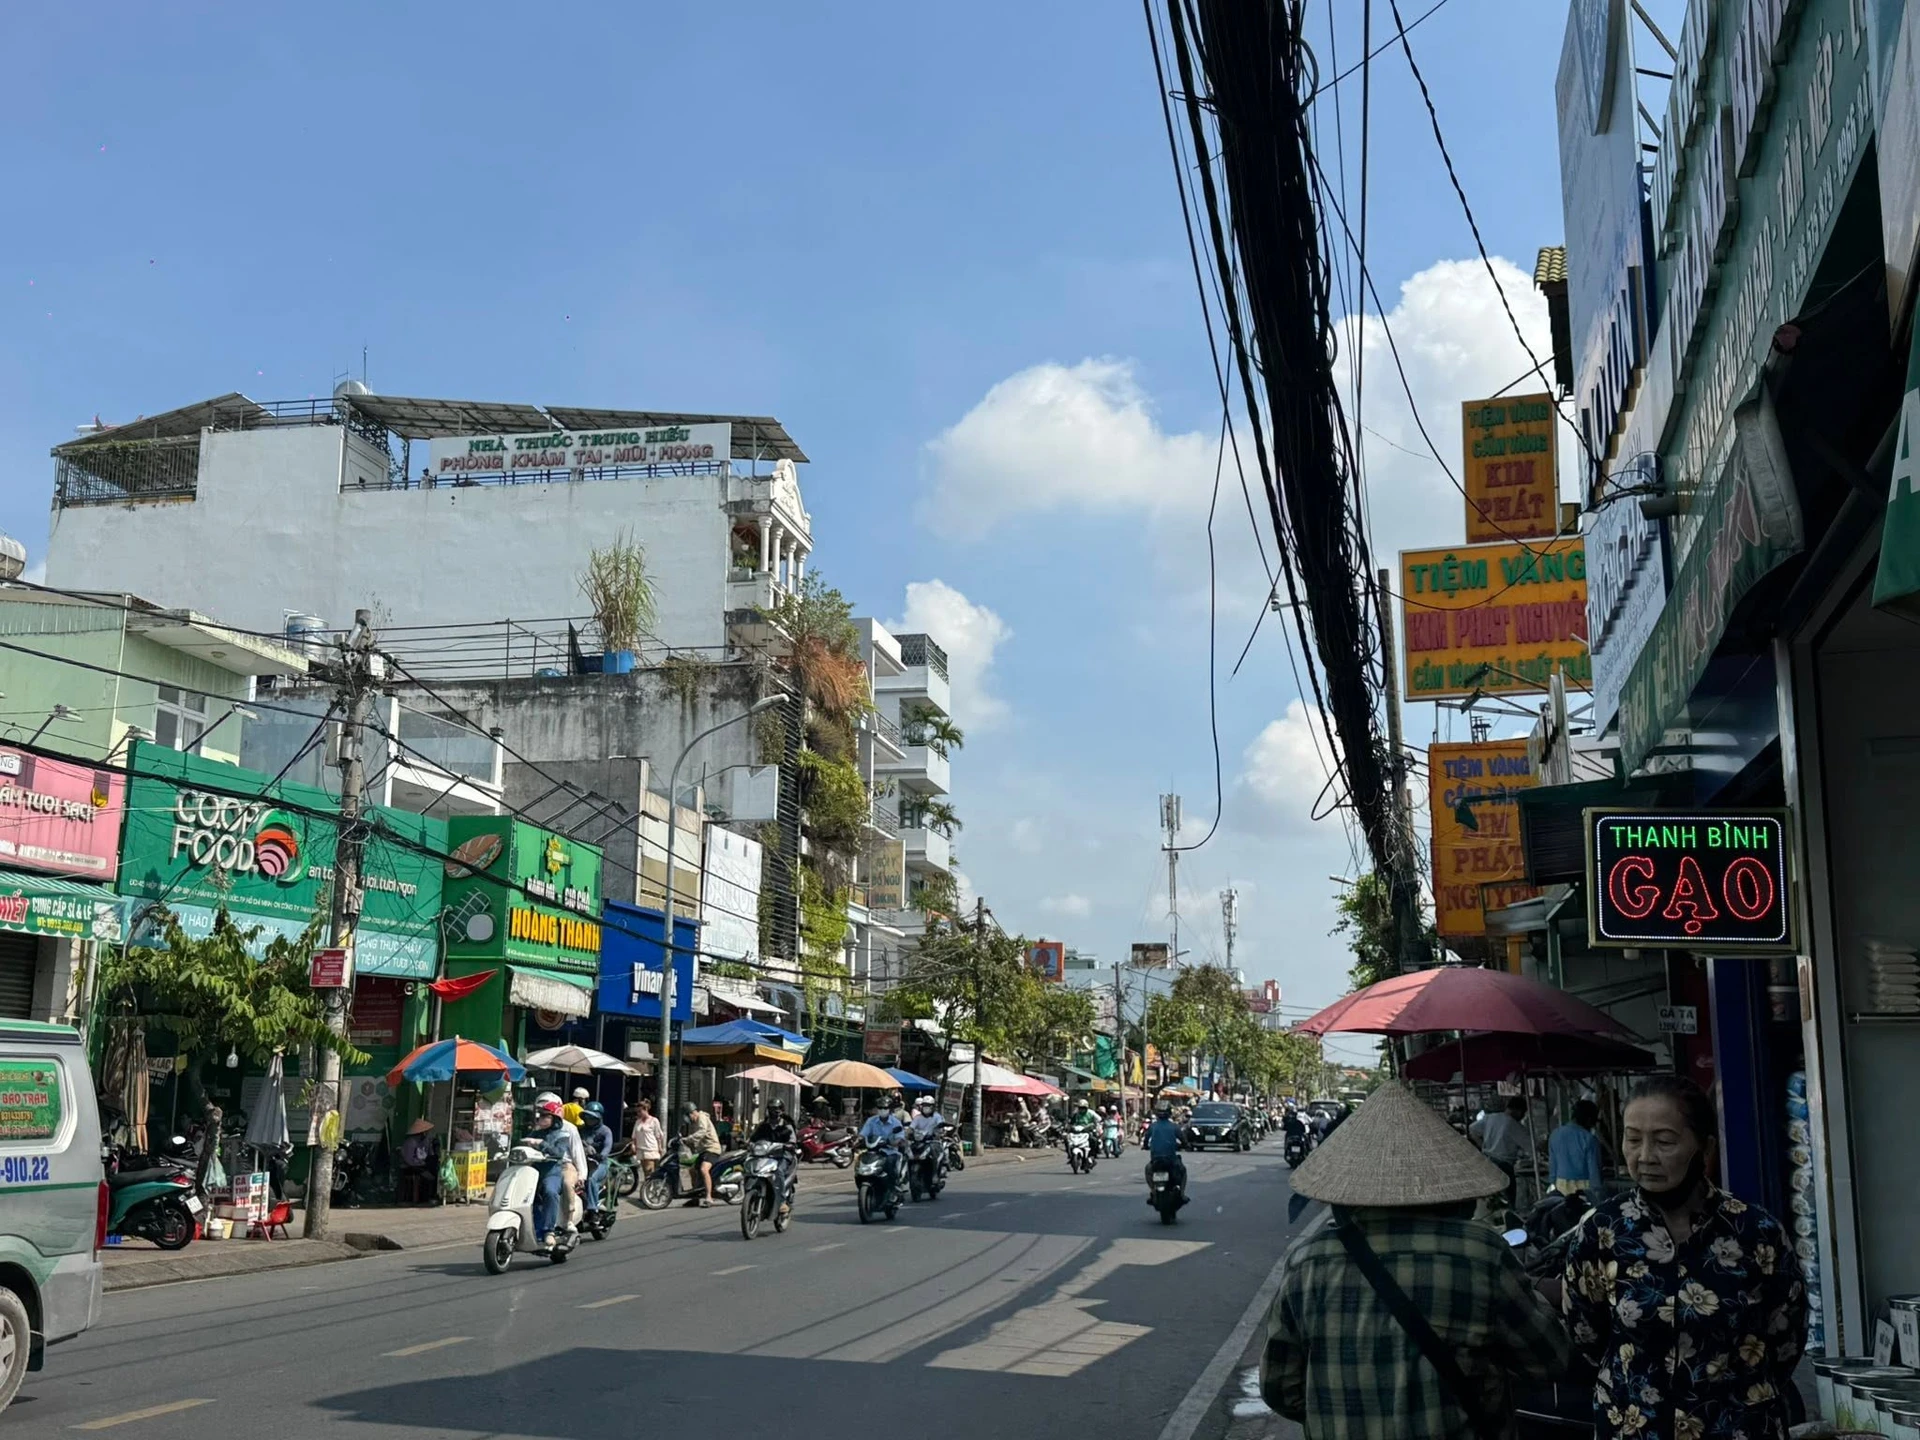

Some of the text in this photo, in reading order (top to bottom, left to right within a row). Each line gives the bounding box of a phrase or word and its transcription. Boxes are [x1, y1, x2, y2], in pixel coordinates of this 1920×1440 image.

[469, 435, 508, 452] NHÀ
[515, 430, 574, 450] THUỐC
[578, 433, 640, 446] TRUNG
[440, 443, 713, 471] PHÒNG KHÁM TAI MŨI HỌNG
[1485, 460, 1534, 488] KIM
[1477, 488, 1544, 523] PHÁT
[1410, 547, 1586, 598] TIỆM VÀNG
[1408, 610, 1448, 652] KIM
[1455, 597, 1510, 649] PHÁT
[1515, 591, 1589, 645] NGUYÊ
[1444, 754, 1530, 779] TIỆM VÀNG
[1461, 813, 1510, 839] IM
[1609, 821, 1769, 849] THANH BÌNH
[33, 897, 52, 915] CUNG
[51, 896, 67, 918] CẤP
[1608, 855, 1773, 933] GẠO
[511, 905, 600, 951] HOÀNG THANH
